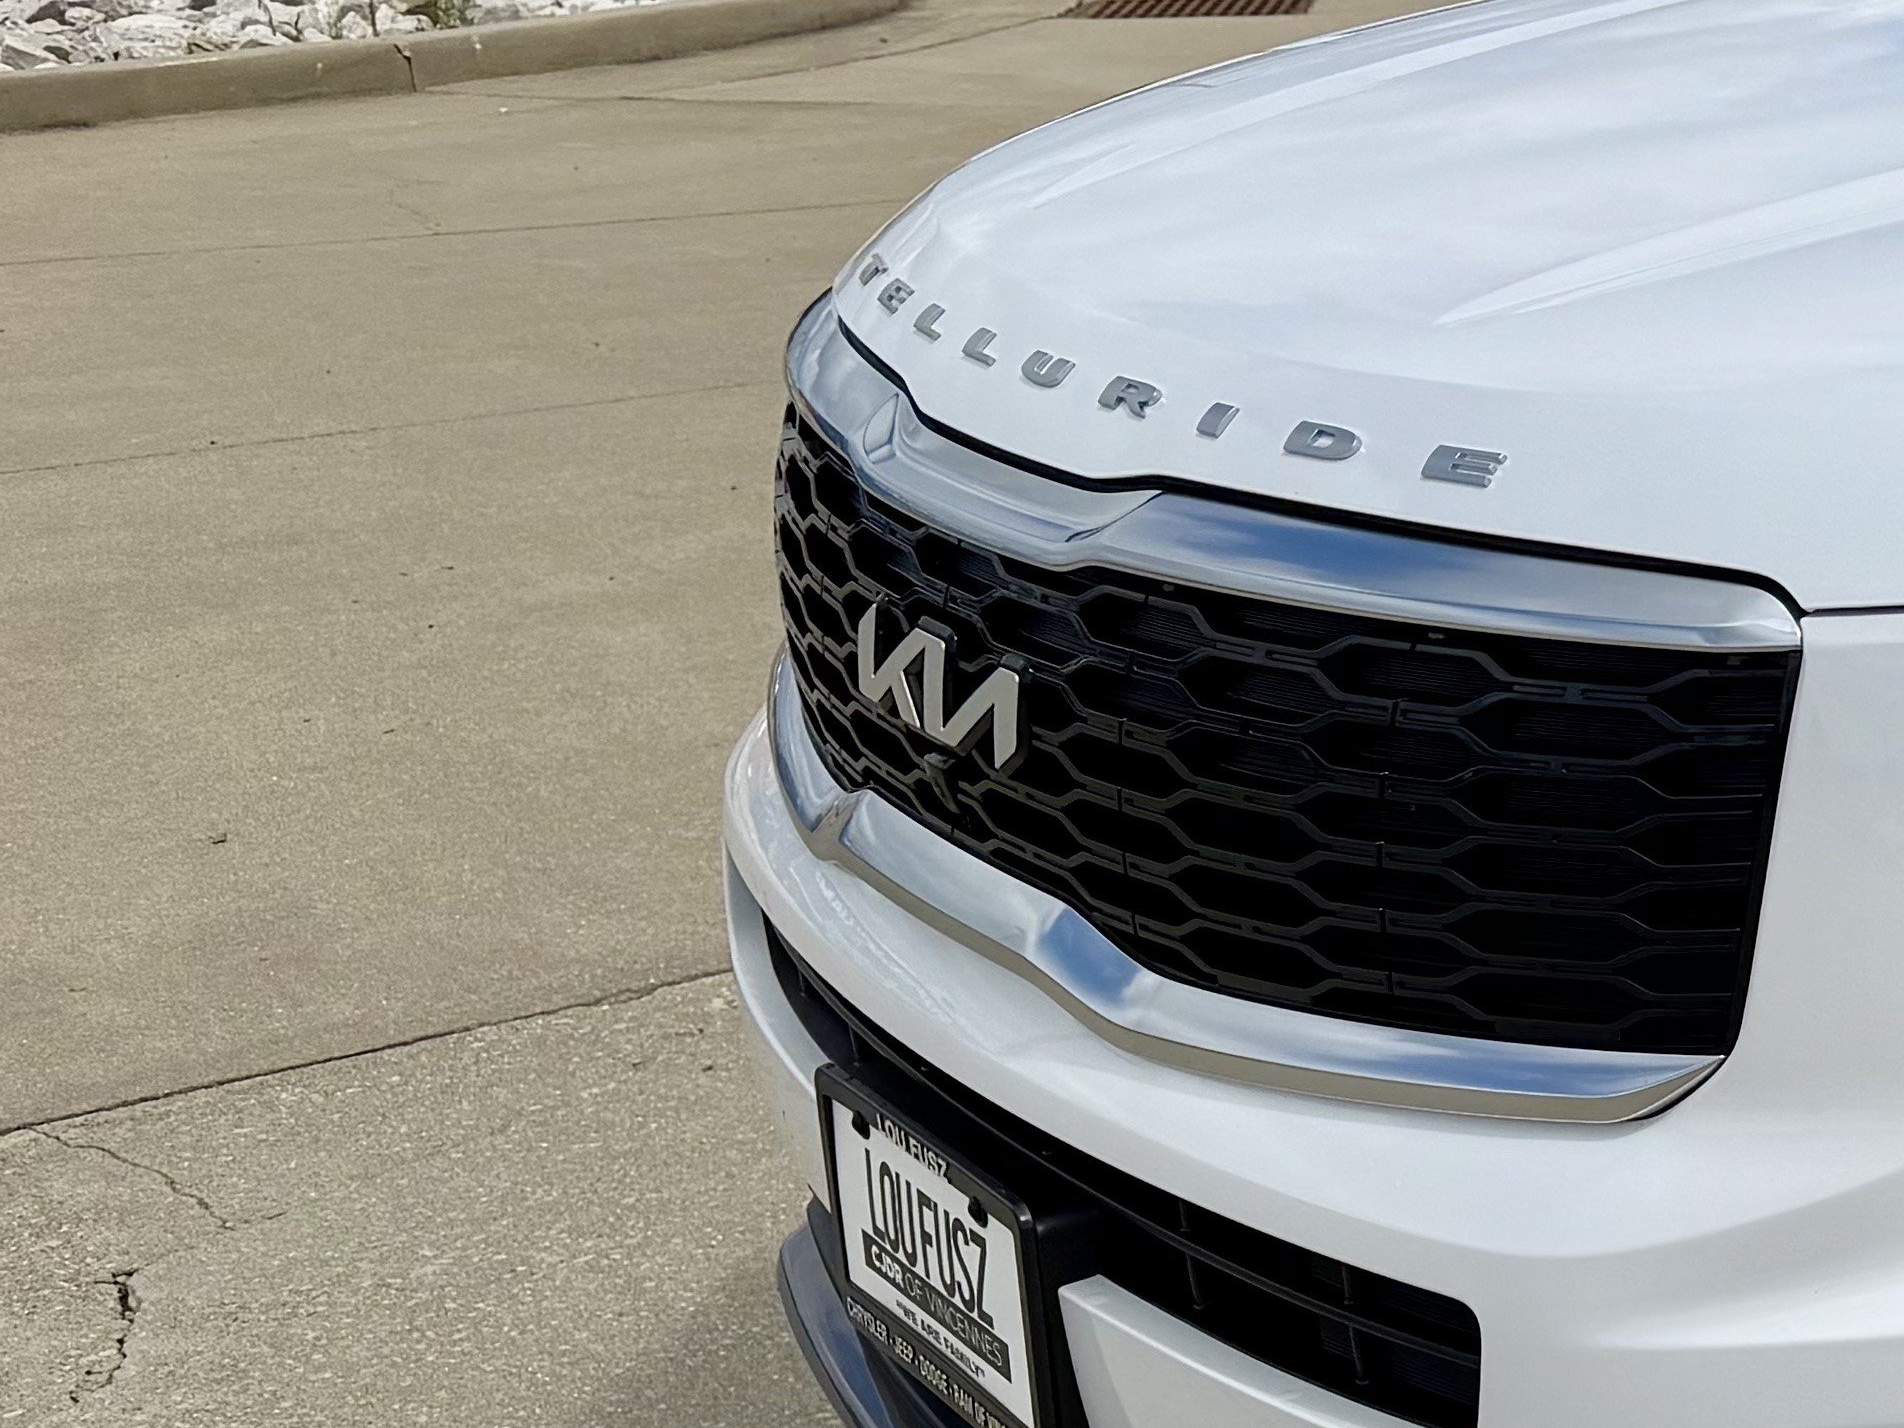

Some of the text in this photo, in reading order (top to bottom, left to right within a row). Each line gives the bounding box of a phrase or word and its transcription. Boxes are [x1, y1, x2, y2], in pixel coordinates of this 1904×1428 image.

[859, 252, 1509, 489] TELLURIDE
[857, 602, 1020, 770] KIA
[876, 1112, 948, 1178] LOU FUSZ
[864, 1147, 995, 1330] LOU FUSZ
[870, 1243, 1003, 1367] CJDR OF VINCENNES
[921, 1323, 942, 1348] ARE
